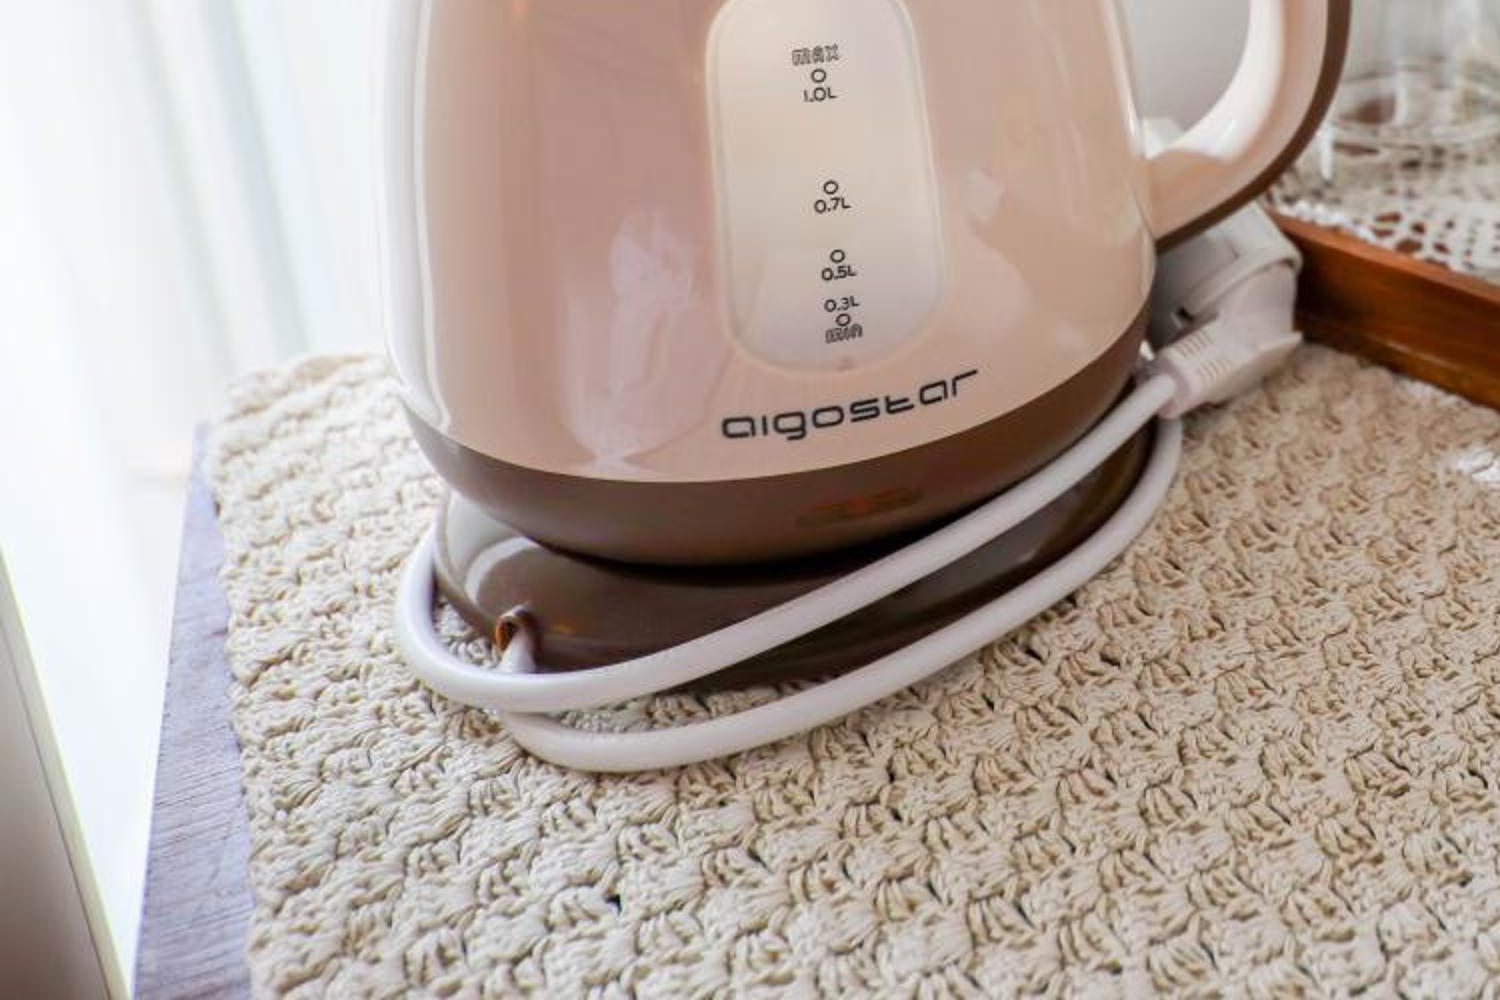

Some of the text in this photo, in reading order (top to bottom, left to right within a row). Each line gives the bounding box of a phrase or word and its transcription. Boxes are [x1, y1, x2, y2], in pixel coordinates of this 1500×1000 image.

[803, 86, 838, 102] 1.0L
[814, 197, 851, 213] 0.7L
[821, 264, 857, 281] 0.5L
[824, 296, 861, 312] 0.3L
[721, 369, 978, 441] aigostar
